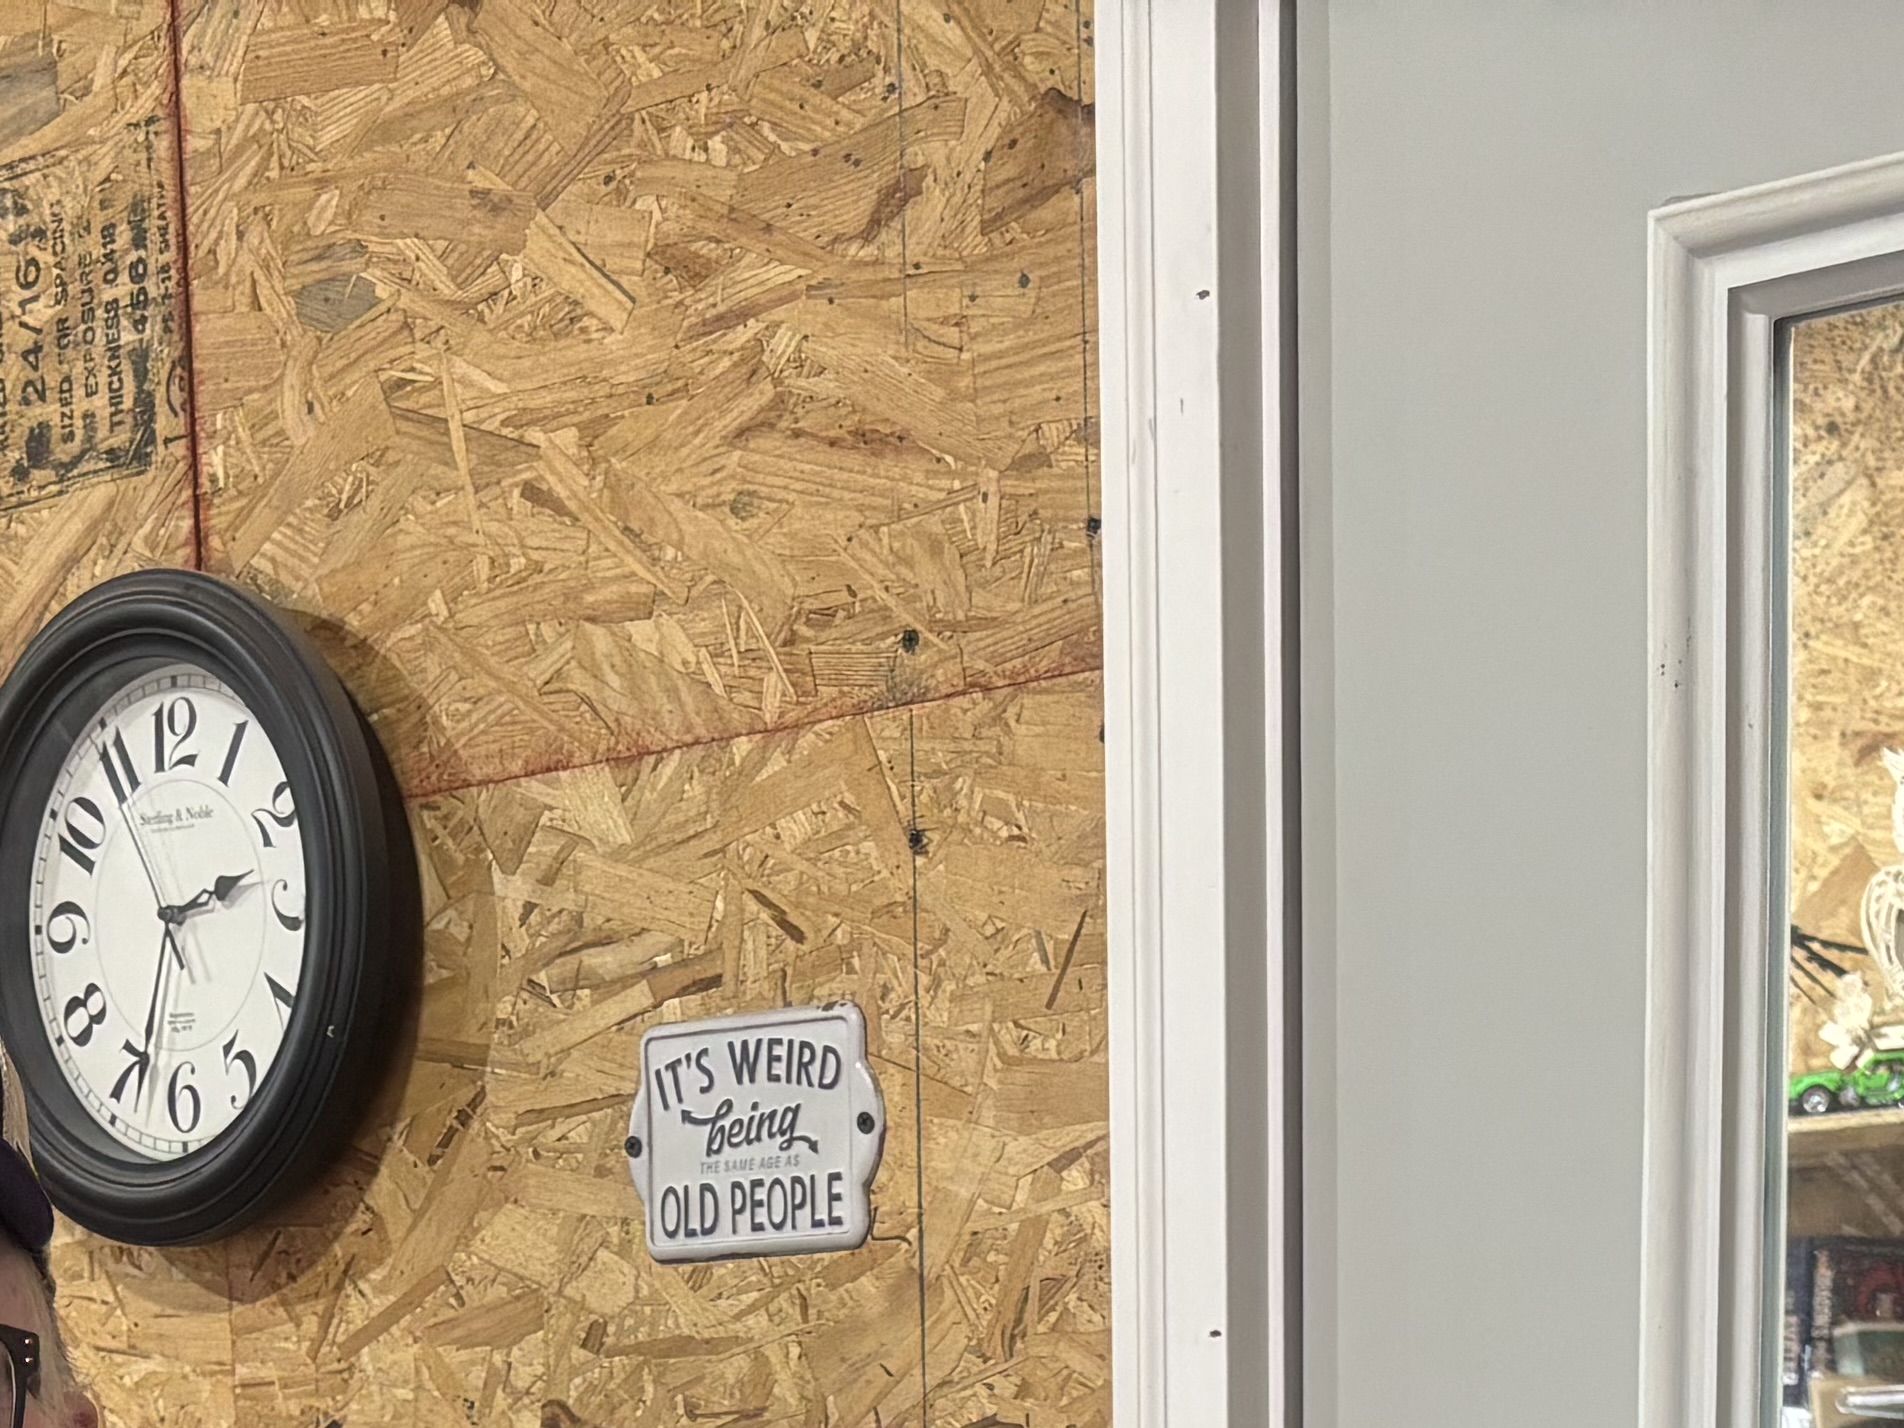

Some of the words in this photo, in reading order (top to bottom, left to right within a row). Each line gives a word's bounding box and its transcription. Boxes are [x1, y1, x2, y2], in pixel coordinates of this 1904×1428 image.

[106, 297, 125, 431] THICKNESS
[59, 375, 75, 443] SIZED
[153, 697, 199, 773] 12
[219, 719, 248, 787] 1
[57, 796, 105, 875] 10
[252, 781, 296, 848] 2
[48, 901, 90, 955] 9
[65, 982, 106, 1048] 8
[109, 1038, 148, 1113] 7
[167, 1061, 200, 1133] 6
[222, 1030, 257, 1109] 5
[654, 1048, 715, 1112] IT'S
[727, 1037, 842, 1091] WEIRD
[705, 1098, 801, 1157] being
[700, 1161, 720, 1175] THE
[723, 1157, 755, 1172] SAME
[758, 1156, 782, 1169] AGE
[784, 1155, 800, 1167] AS
[660, 1181, 719, 1238] OLD
[730, 1171, 843, 1234] PEOPLE
